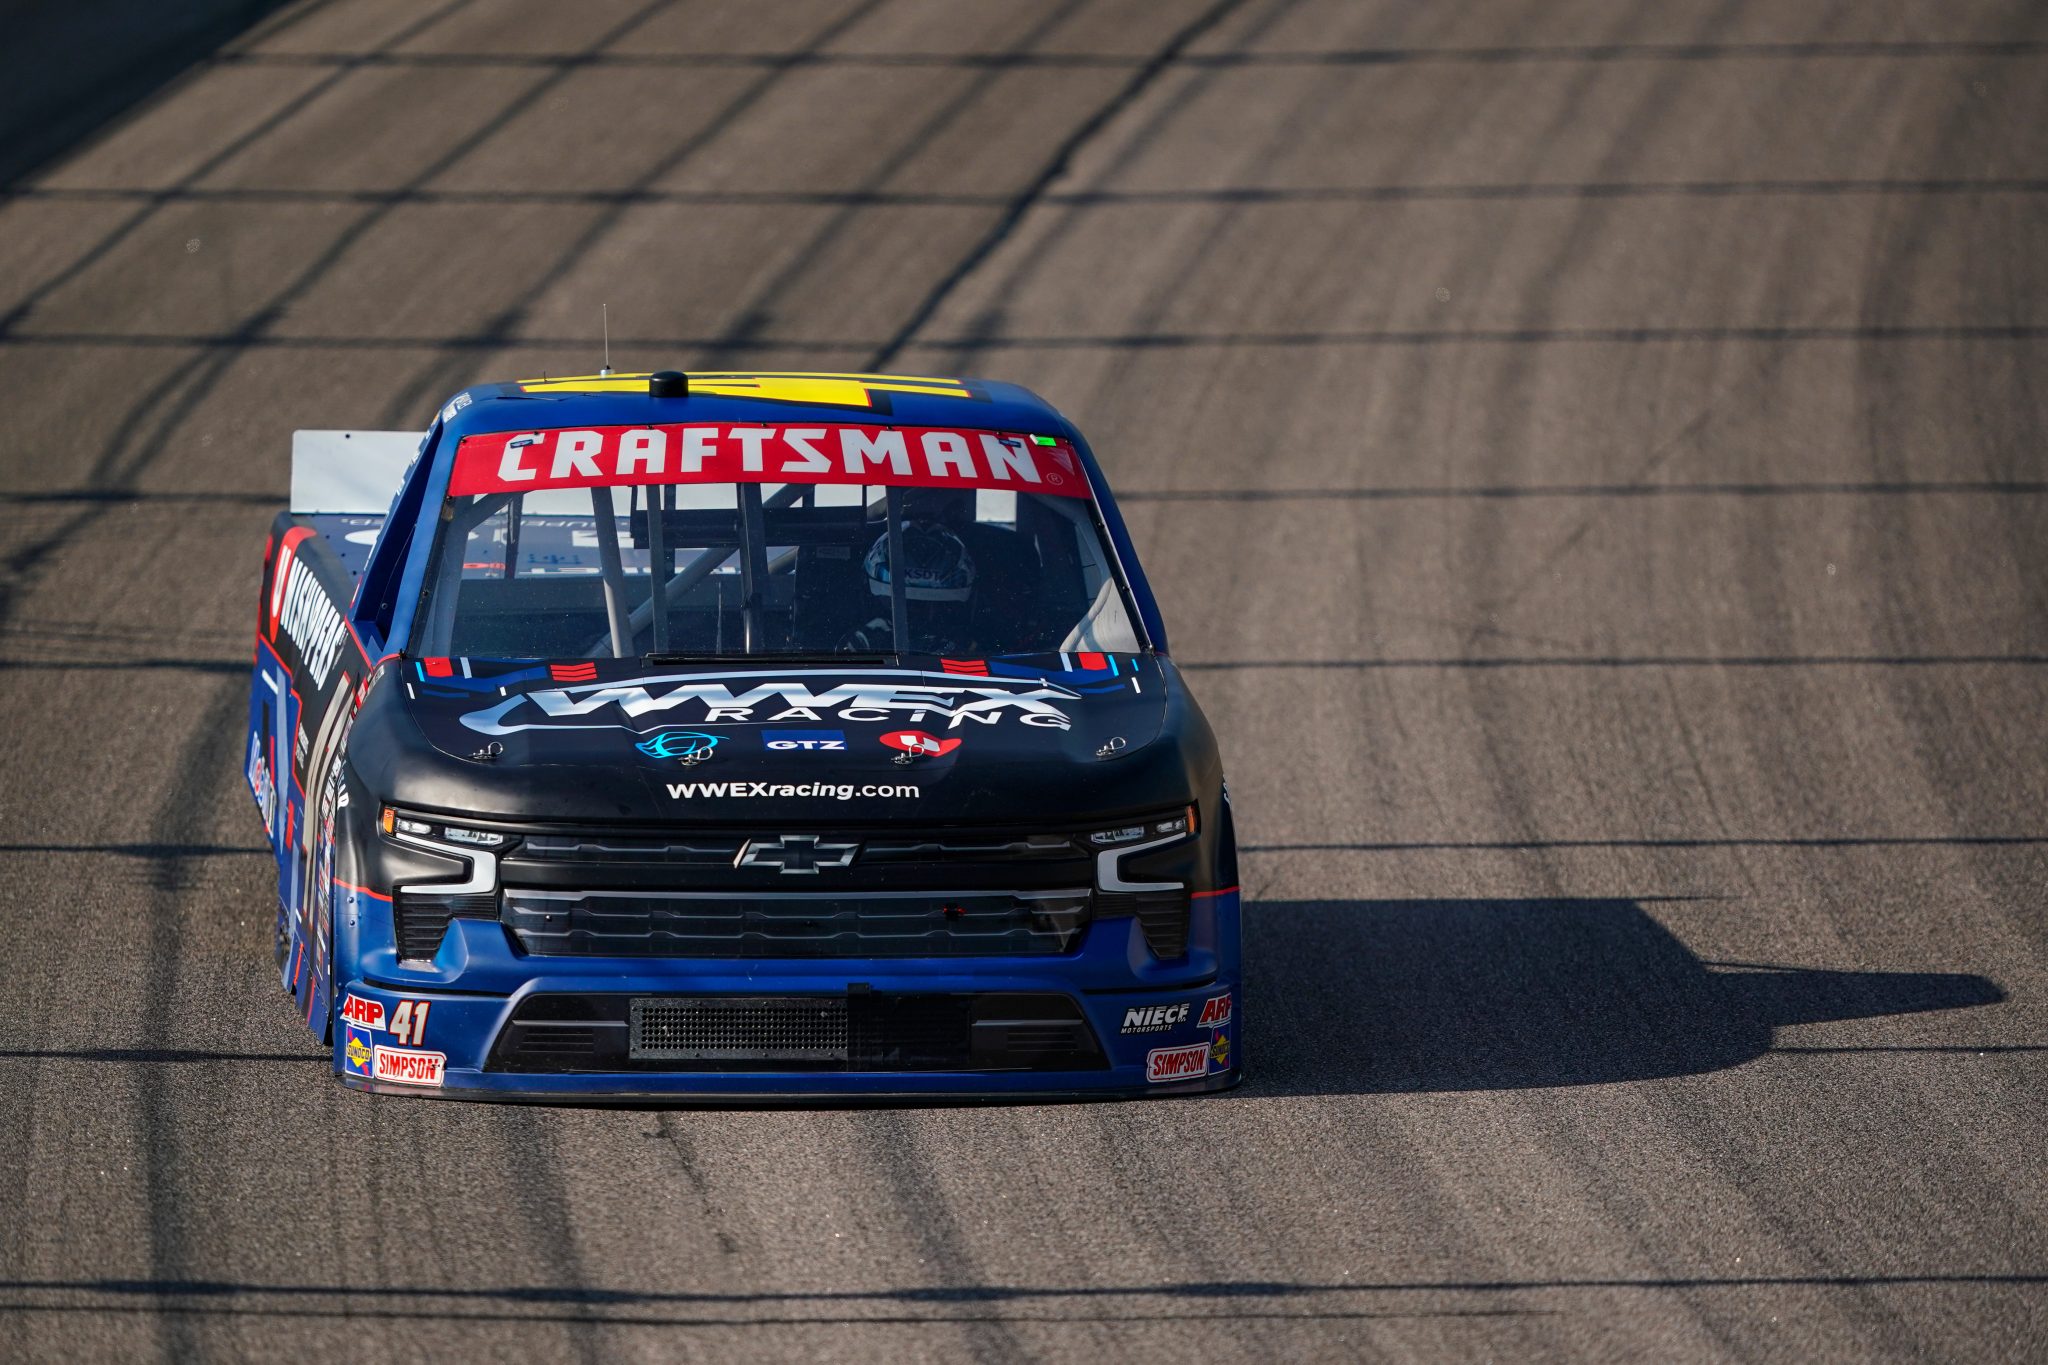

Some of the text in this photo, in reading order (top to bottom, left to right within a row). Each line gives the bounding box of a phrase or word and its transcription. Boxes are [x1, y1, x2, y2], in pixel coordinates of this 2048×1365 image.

[497, 427, 1042, 484] CRAFTSMAN
[526, 682, 1080, 721] WWEX
[704, 706, 1071, 731] RACING
[766, 740, 845, 750] GTZ
[666, 782, 920, 800] WWEXracing.com
[344, 996, 383, 1024] ARP
[389, 1000, 431, 1046] 41
[1123, 1003, 1190, 1027] NIECE
[1121, 1024, 1172, 1034] MOTORSPORTS
[347, 1044, 371, 1060] SUNOCO
[1153, 1049, 1206, 1076] SIMPSON
[379, 1053, 439, 1080] SIMPSON
